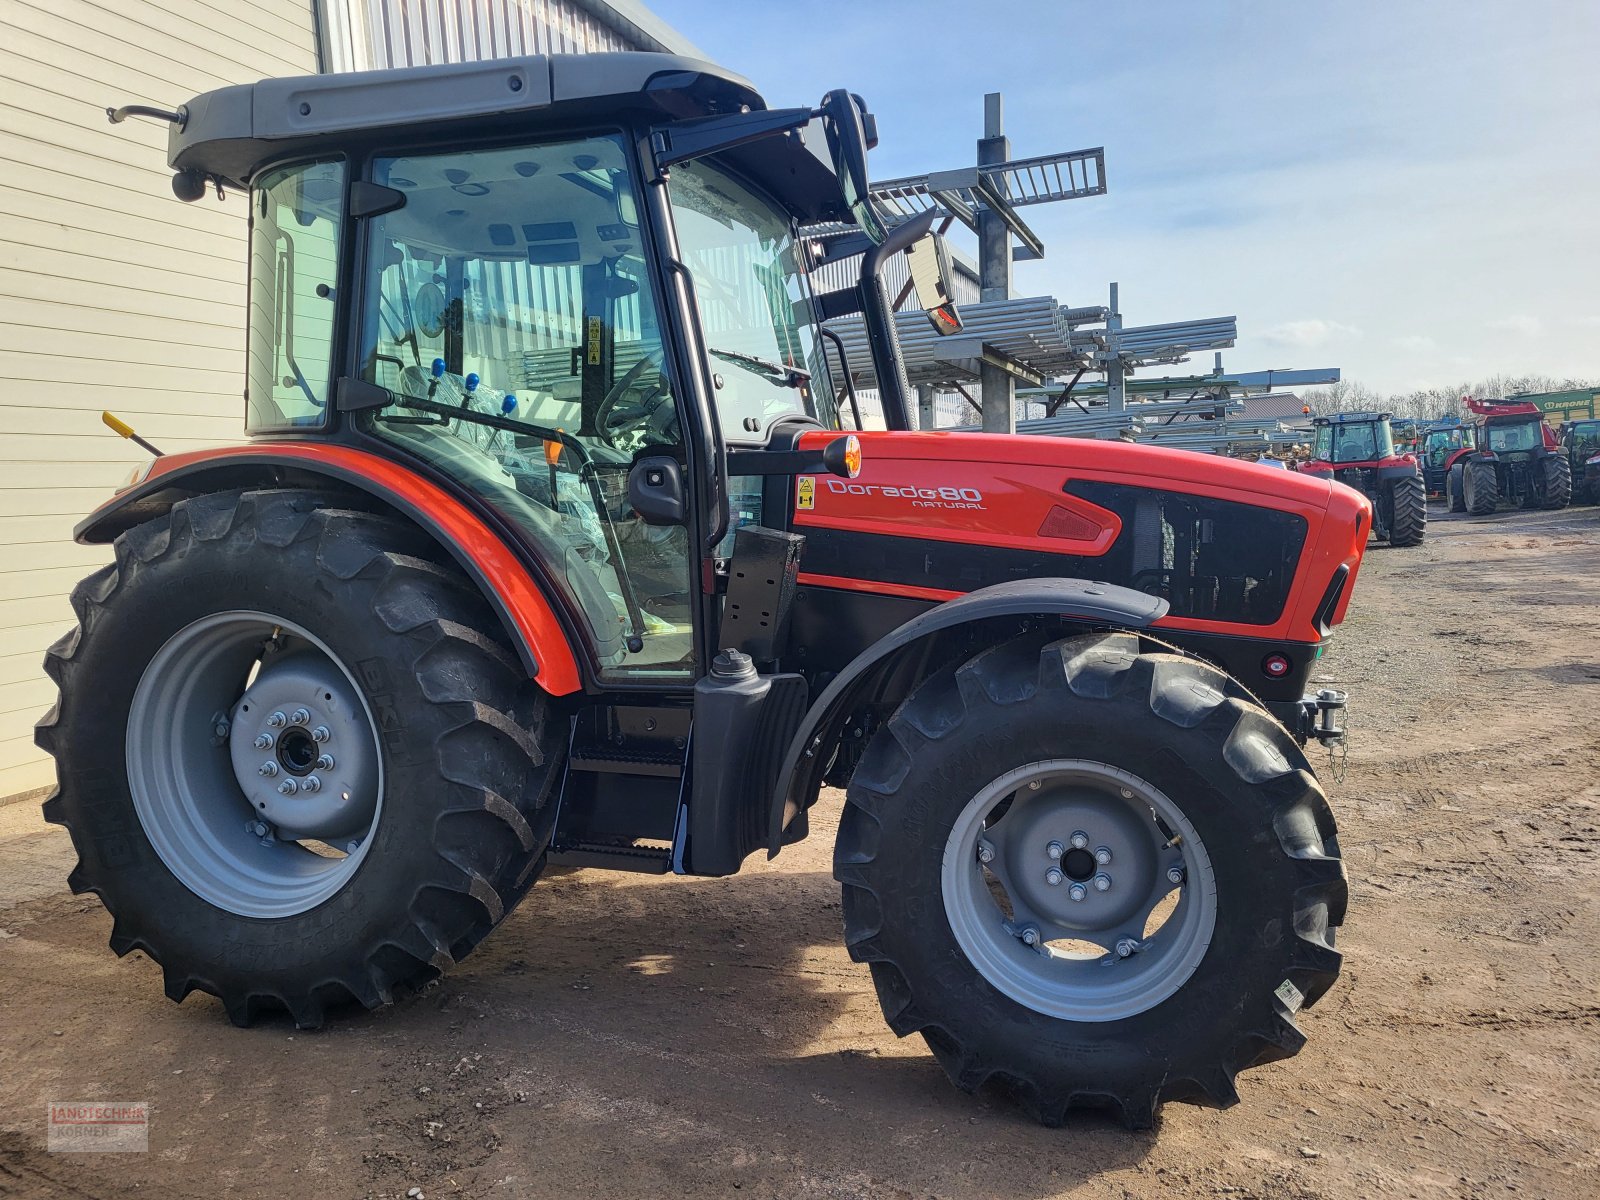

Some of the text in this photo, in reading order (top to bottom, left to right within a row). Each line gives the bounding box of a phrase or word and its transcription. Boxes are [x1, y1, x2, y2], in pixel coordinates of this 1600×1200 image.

[1555, 399, 1591, 409] KRONE
[826, 479, 984, 501] Dorado 80
[911, 500, 988, 511] NATURAL
